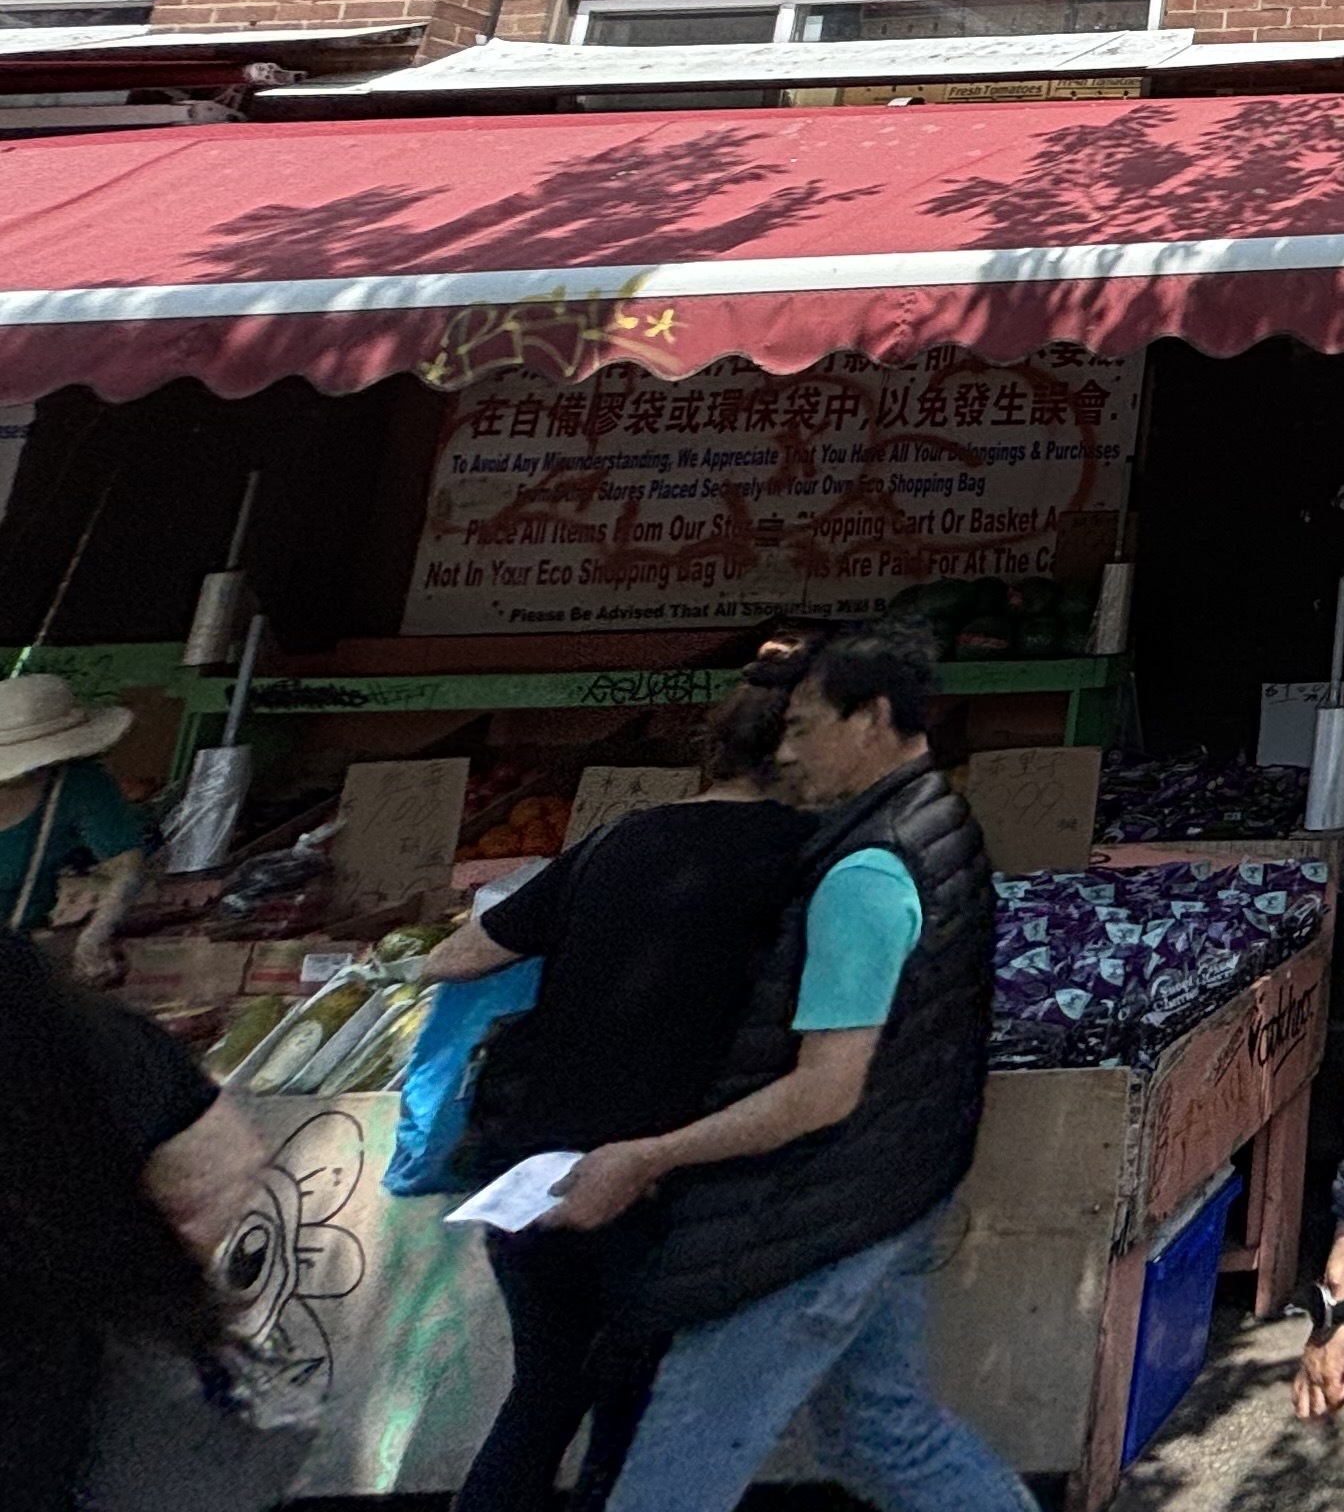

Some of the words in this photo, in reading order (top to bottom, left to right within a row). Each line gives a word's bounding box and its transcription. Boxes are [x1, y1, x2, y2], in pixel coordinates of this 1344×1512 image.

[949, 85, 983, 97] Fresh
[984, 83, 1043, 96] Tomatoes
[453, 454, 468, 473] To
[470, 454, 507, 473] Avoid
[512, 453, 539, 476] Any
[678, 449, 699, 466] We
[702, 448, 778, 470] Appreciate
[820, 445, 846, 464] You
[889, 442, 909, 462] All
[913, 442, 946, 463] Your
[1031, 443, 1042, 462] &
[598, 480, 645, 501] Stores
[648, 479, 698, 500] Placed
[887, 473, 953, 498] Shopping
[957, 473, 986, 497] Bag
[520, 518, 547, 543] All
[670, 514, 706, 541] Our
[940, 508, 965, 534] Or
[969, 506, 1039, 533] Basket
[425, 561, 461, 589] Not
[464, 560, 484, 587] In
[490, 559, 532, 587] Your
[535, 558, 574, 586] Eco
[963, 549, 987, 574] At
[993, 548, 1030, 573] The
[669, 602, 709, 619] That
[712, 601, 737, 618] All
